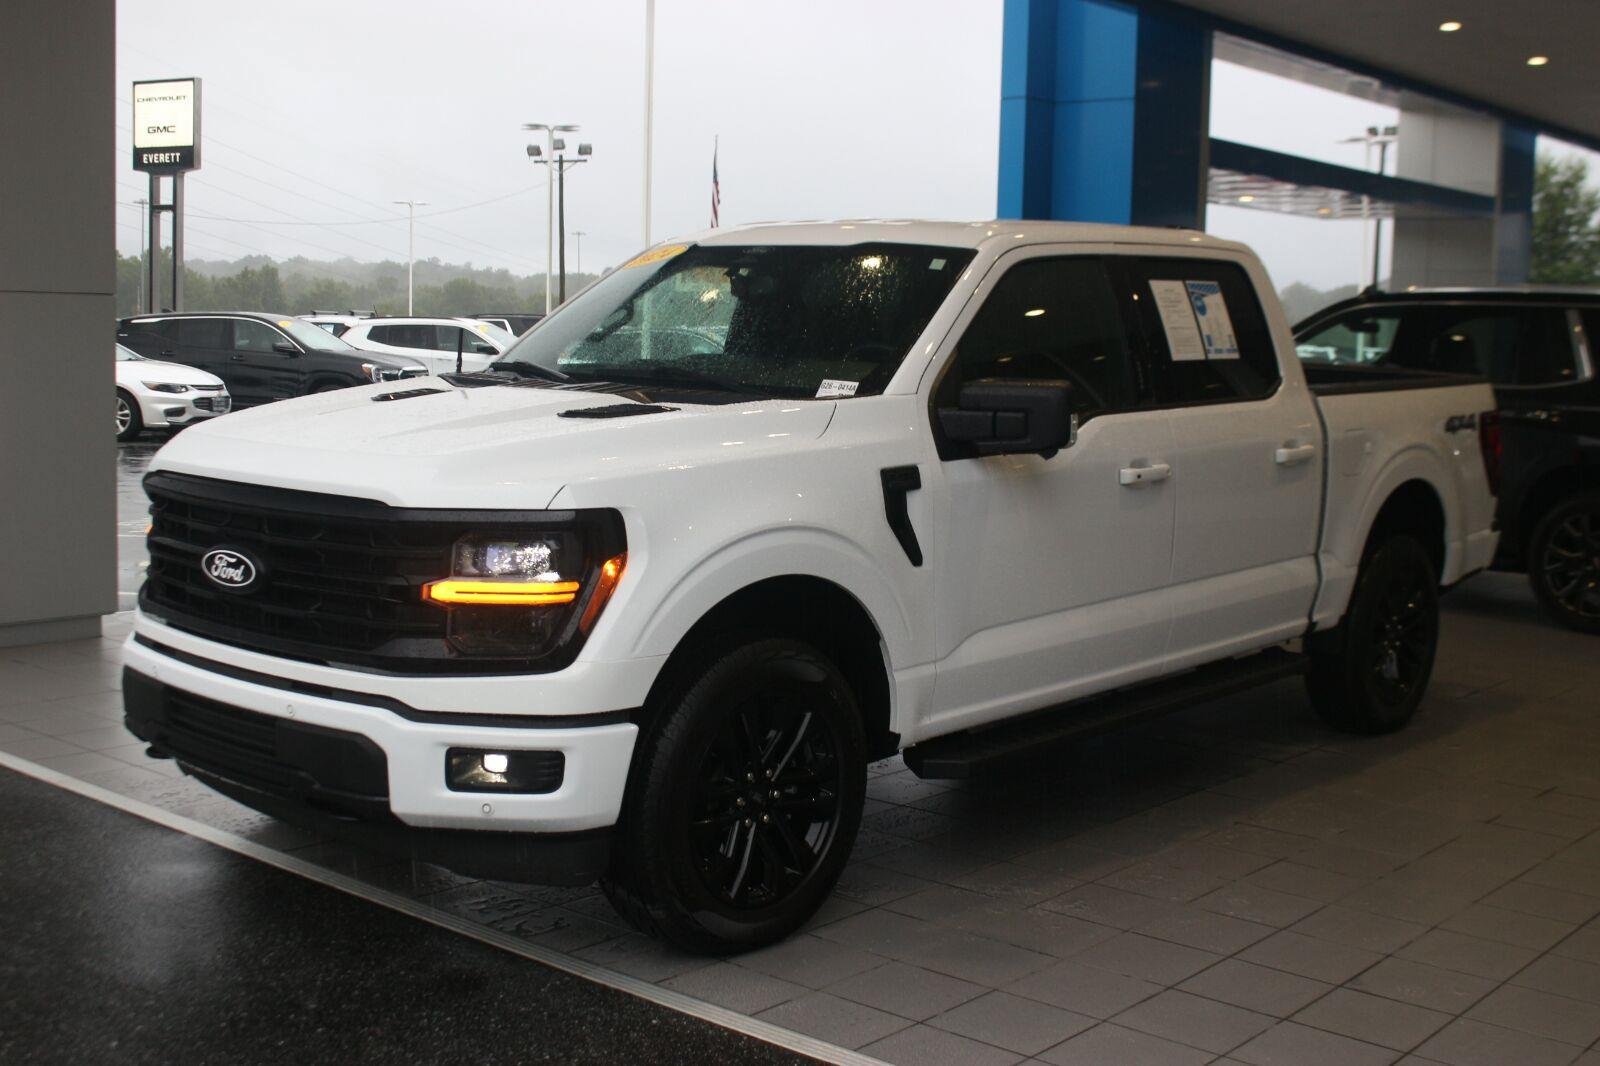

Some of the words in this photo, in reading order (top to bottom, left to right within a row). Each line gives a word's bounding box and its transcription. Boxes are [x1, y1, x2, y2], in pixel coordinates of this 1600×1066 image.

[137, 95, 186, 103] CHEVROLET
[147, 125, 176, 134] GMC
[142, 152, 181, 164] EVERETT
[211, 554, 245, 581] Ford
